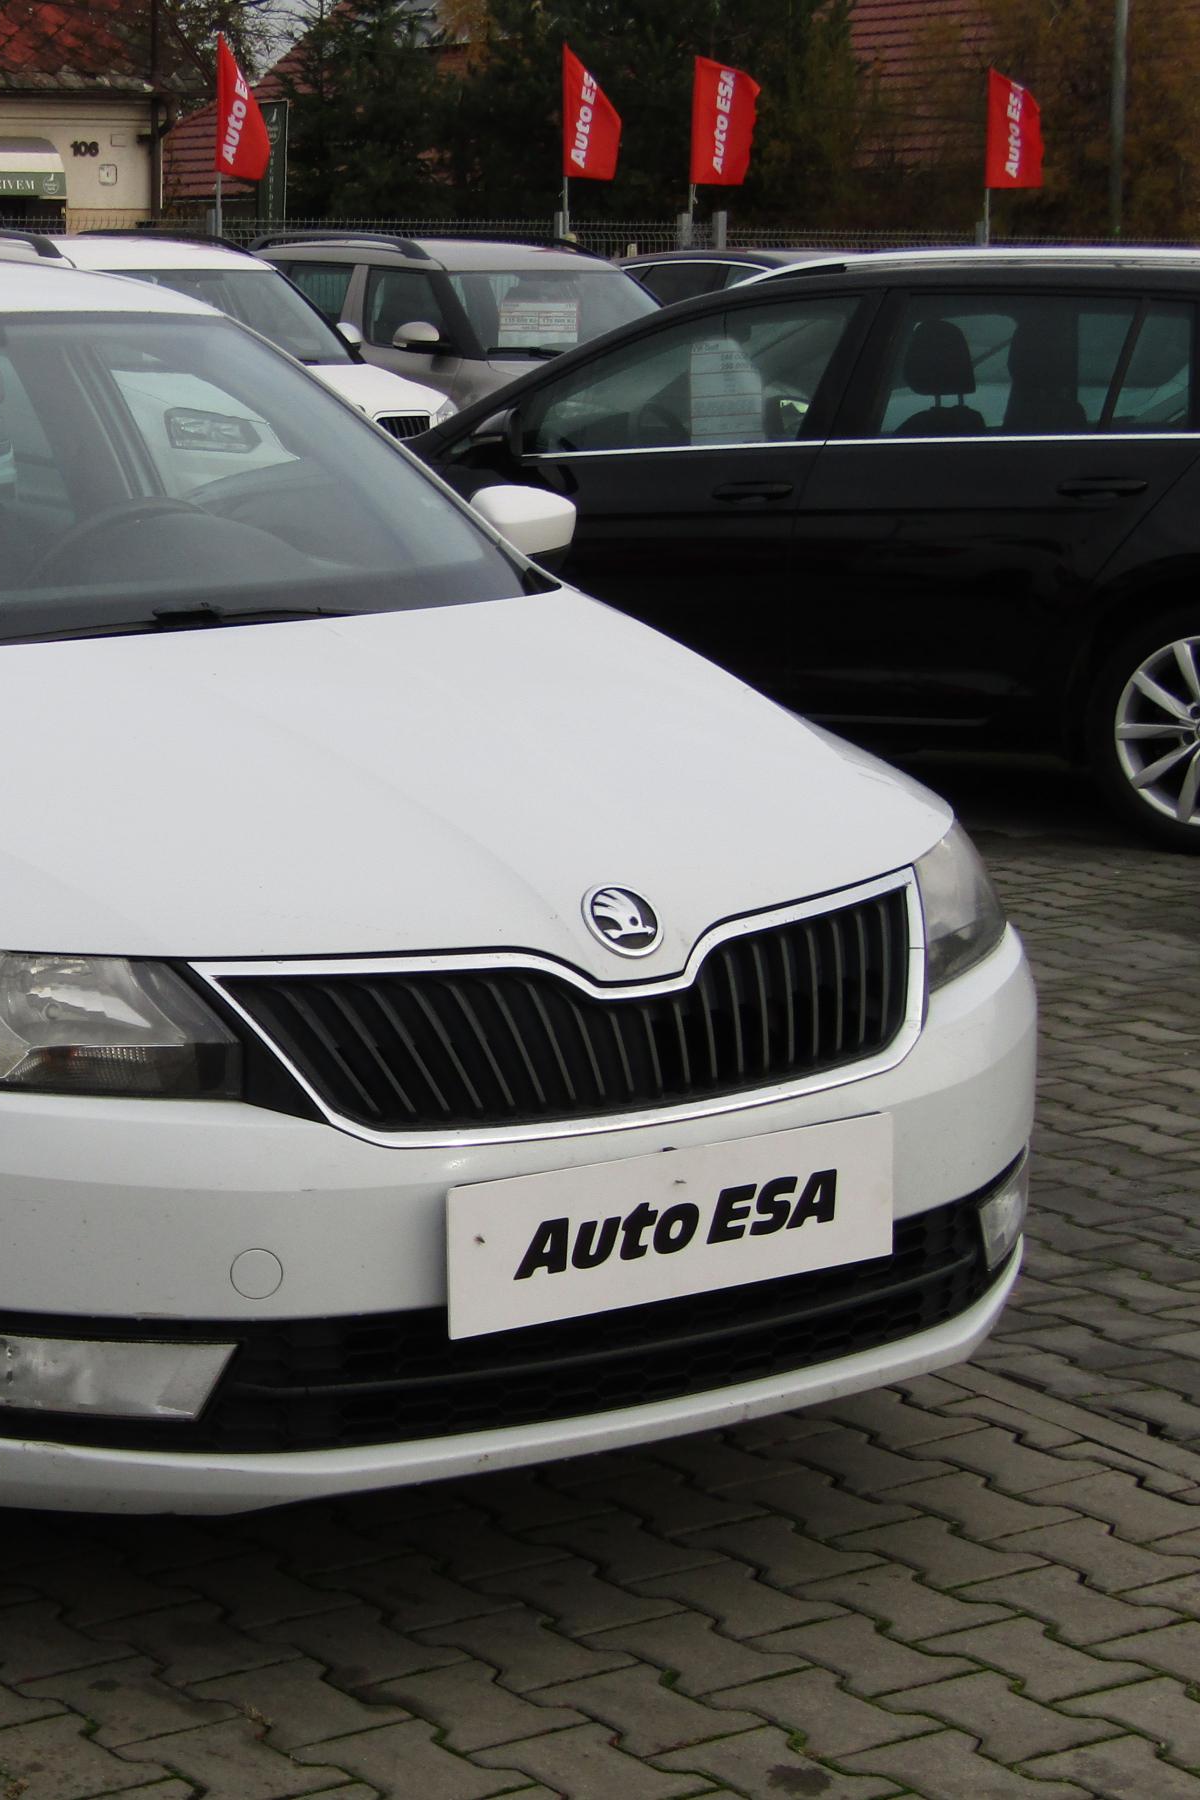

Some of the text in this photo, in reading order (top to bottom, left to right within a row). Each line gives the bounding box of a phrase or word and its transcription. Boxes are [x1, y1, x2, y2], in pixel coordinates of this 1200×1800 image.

[222, 100, 246, 165] Auto
[571, 70, 598, 169] Auto ES
[712, 69, 737, 175] Auto ESA
[1005, 123, 1021, 177] Auto
[513, 1168, 838, 1281] Auto ESA
